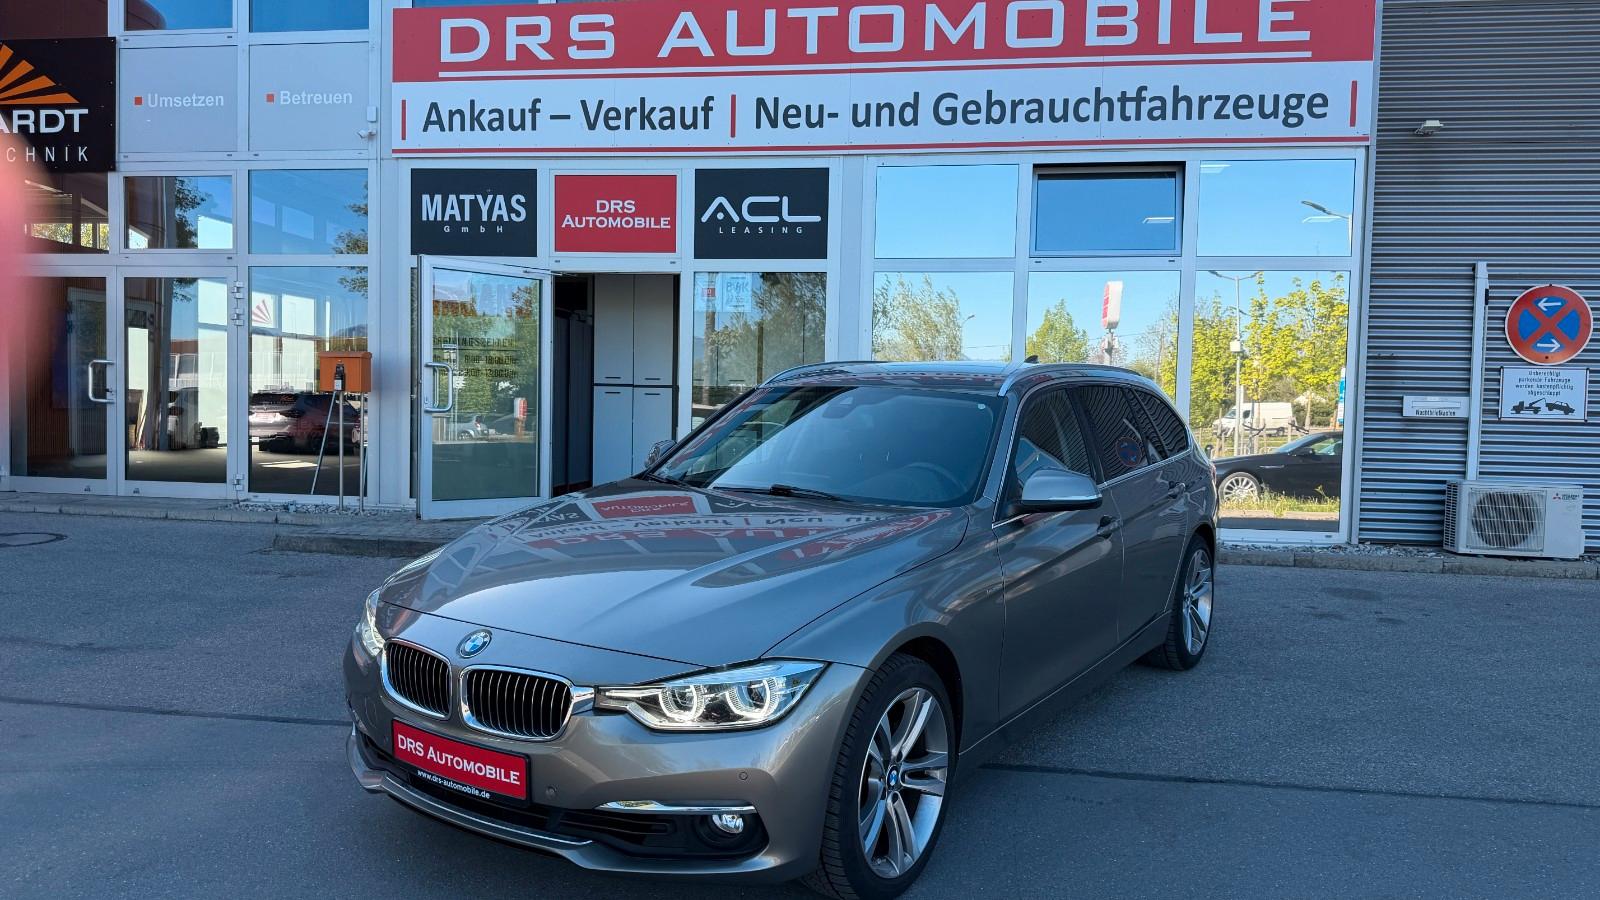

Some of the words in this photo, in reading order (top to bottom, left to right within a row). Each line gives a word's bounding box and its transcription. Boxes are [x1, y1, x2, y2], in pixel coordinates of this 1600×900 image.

[439, 13, 615, 63] DRS
[656, 0, 1311, 58] AUTOMOBILE
[147, 93, 225, 108] Umsetzen
[280, 90, 353, 105] Betreuen
[422, 97, 542, 133] Ankauf
[580, 95, 715, 132] Verkauf
[755, 95, 839, 130] Neu-
[852, 91, 920, 129] und
[932, 85, 1329, 129] Gebrauchtfahrzeuge
[421, 193, 527, 223] MATYAS
[595, 199, 636, 214] DRS
[701, 195, 822, 223] ACL
[561, 214, 671, 229] AUTOMOBILE
[719, 226, 804, 235] LEASING
[397, 733, 425, 757] DRS
[426, 746, 521, 785] AUTOMOBILE
[417, 769, 491, 799] www.drs-automobile.de
